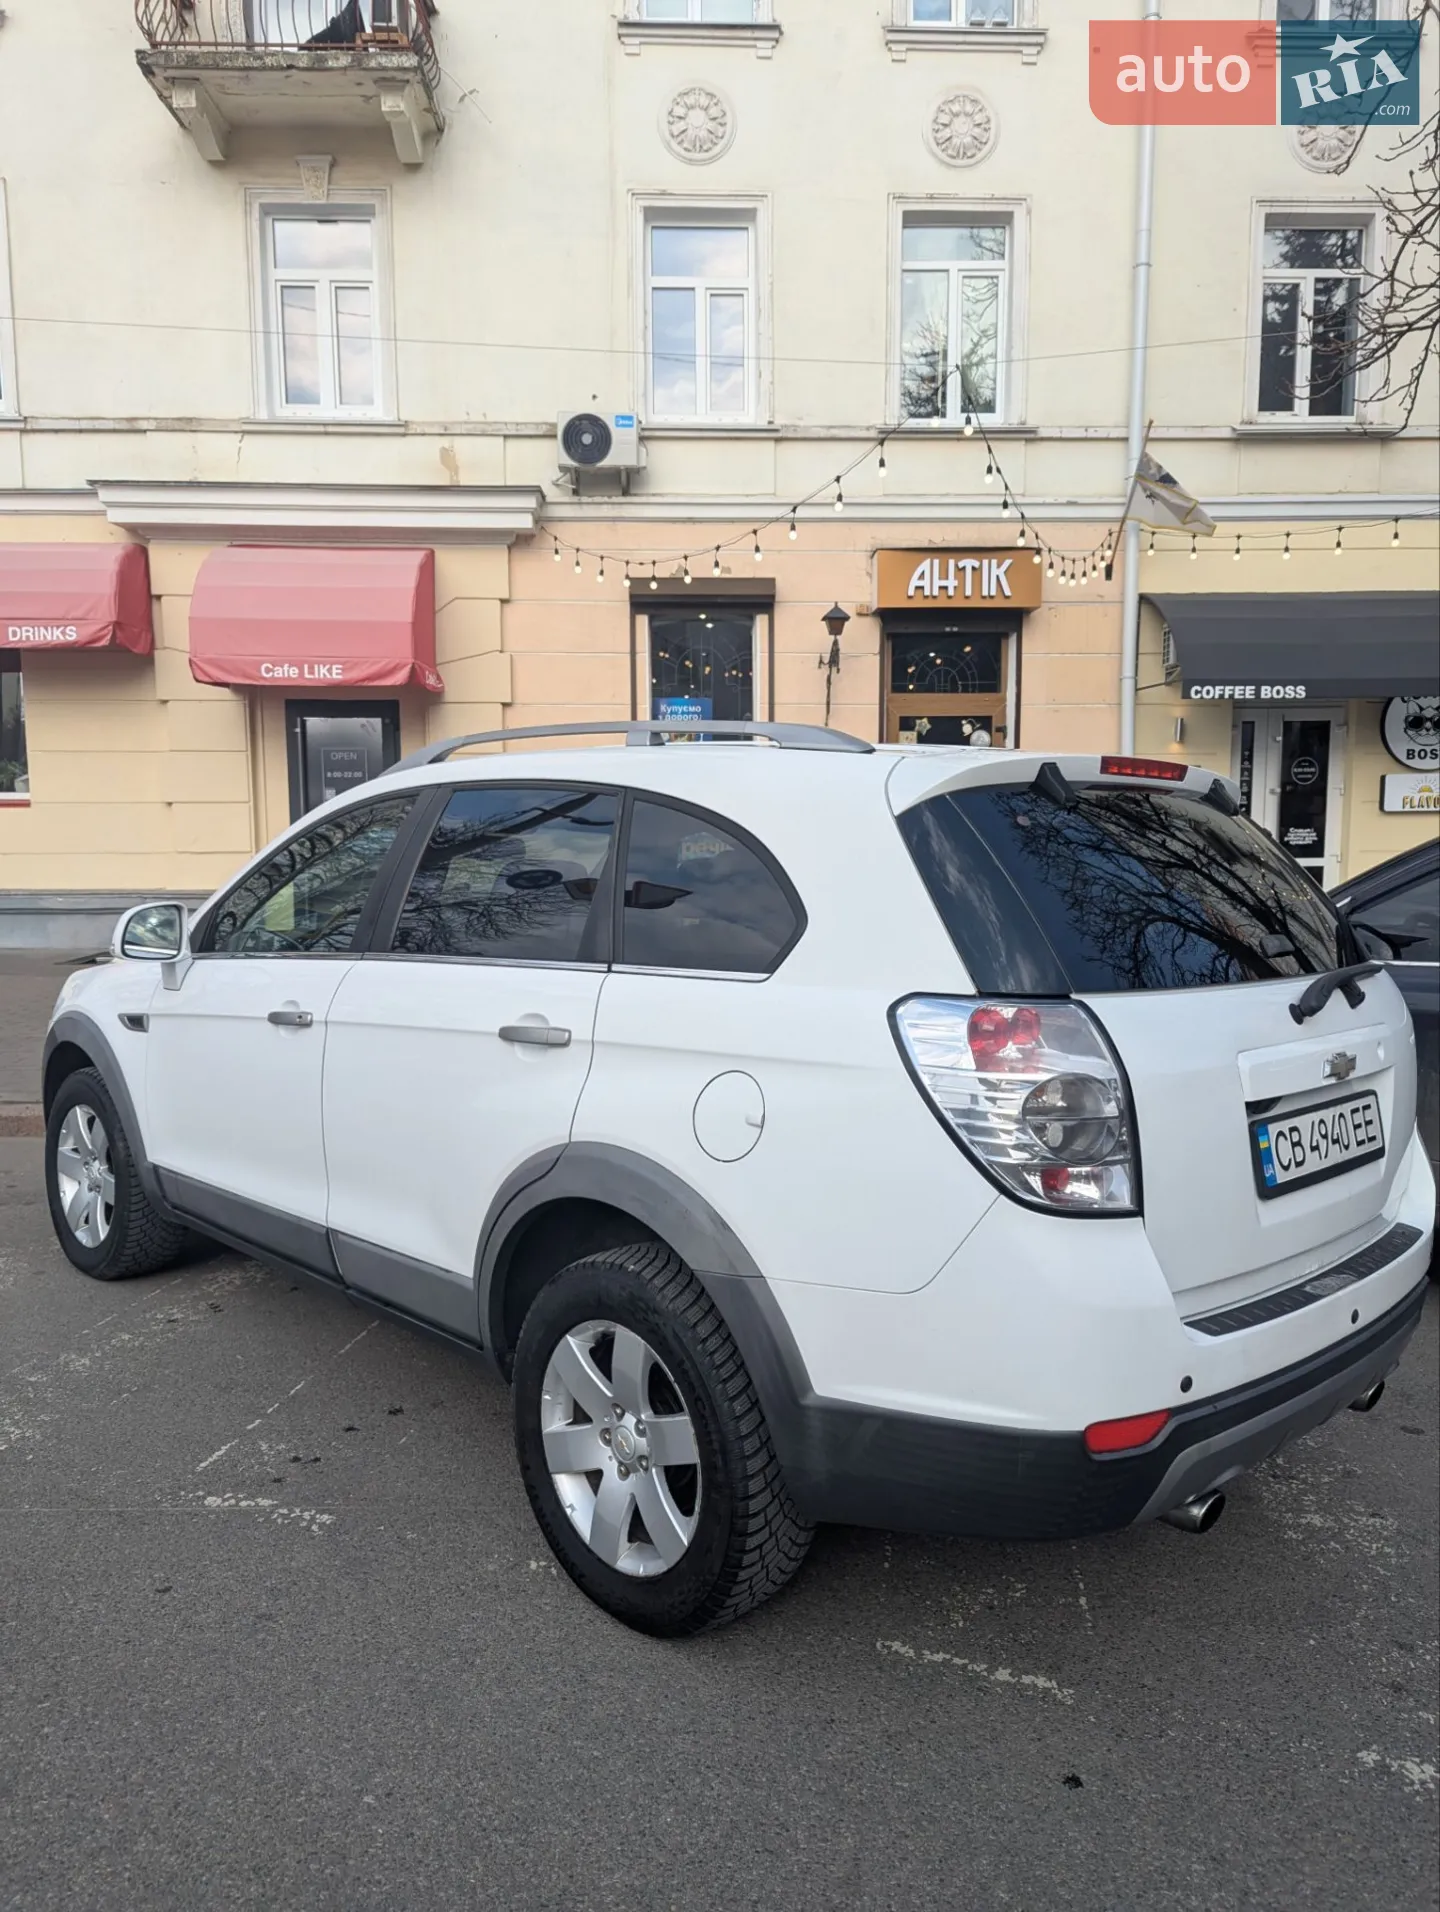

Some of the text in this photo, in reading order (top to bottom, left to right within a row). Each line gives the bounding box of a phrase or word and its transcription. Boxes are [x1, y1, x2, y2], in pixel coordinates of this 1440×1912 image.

[907, 558, 1013, 598] АНТІК
[8, 625, 77, 642] DRINKS
[260, 663, 343, 680] Cafe LIKE
[1190, 685, 1306, 699] COFFEE BOSS
[330, 751, 358, 760] OPEN
[1275, 1104, 1377, 1172] CB 4940 EE
[1264, 1163, 1275, 1177] UA
